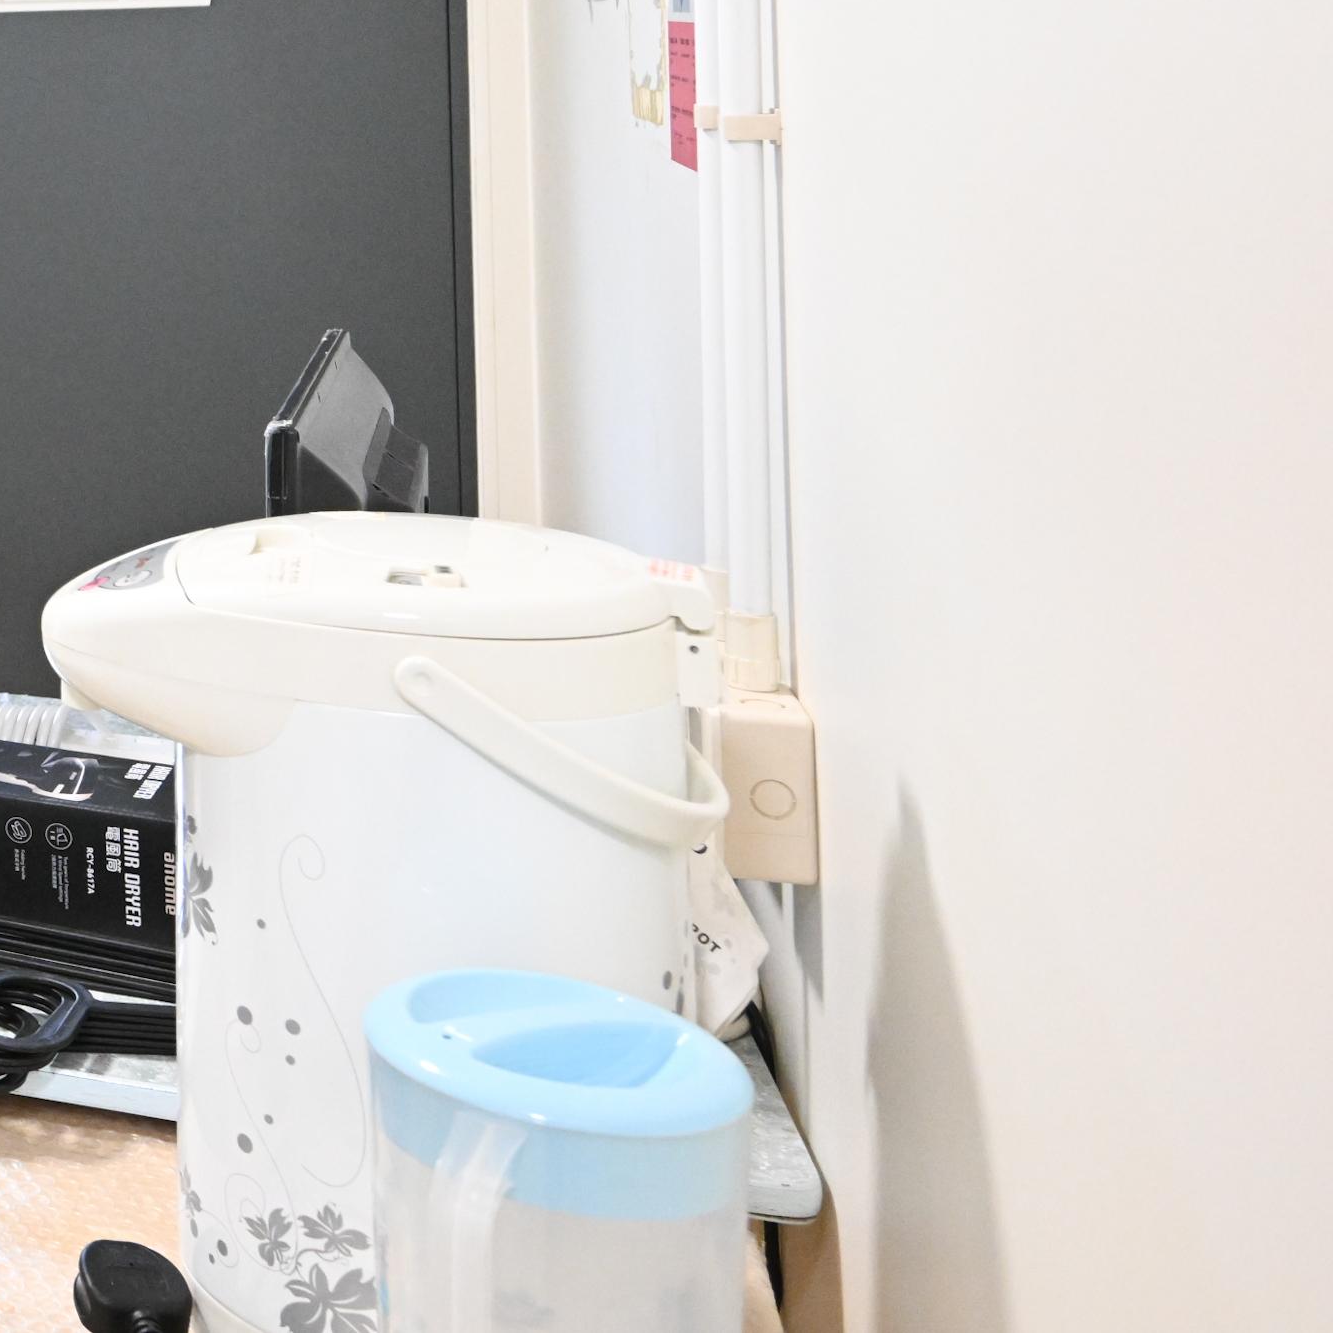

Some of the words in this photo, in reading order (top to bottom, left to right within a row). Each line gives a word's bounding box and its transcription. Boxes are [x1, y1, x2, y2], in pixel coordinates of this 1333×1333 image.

[86, 846, 95, 894] RCY-8617A
[105, 826, 121, 873] 電風筒
[123, 828, 140, 869] HAIR
[124, 872, 142, 927] DRYER
